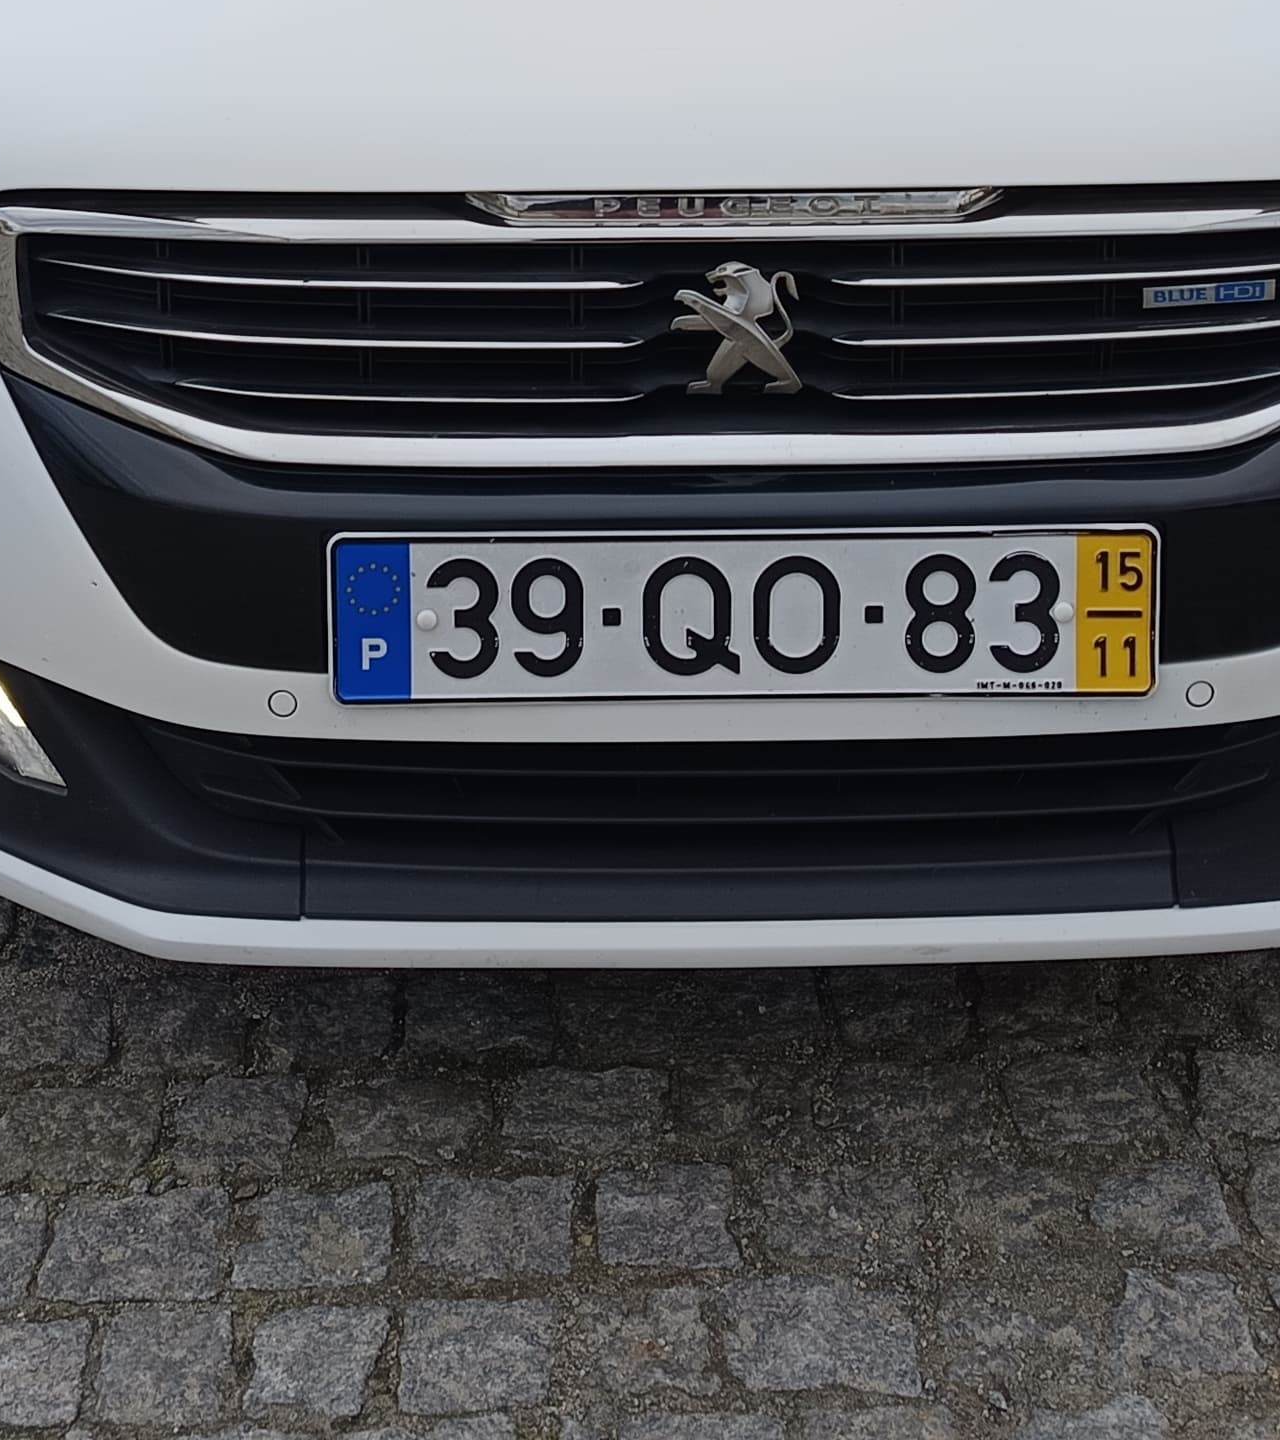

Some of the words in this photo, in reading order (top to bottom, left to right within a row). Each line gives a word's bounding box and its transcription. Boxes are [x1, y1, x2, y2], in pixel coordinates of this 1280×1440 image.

[593, 195, 880, 217] PEUGEOT
[1152, 287, 1208, 303] BLUE
[1095, 550, 1144, 593] 15
[361, 637, 388, 671] P
[1093, 635, 1137, 678] 11
